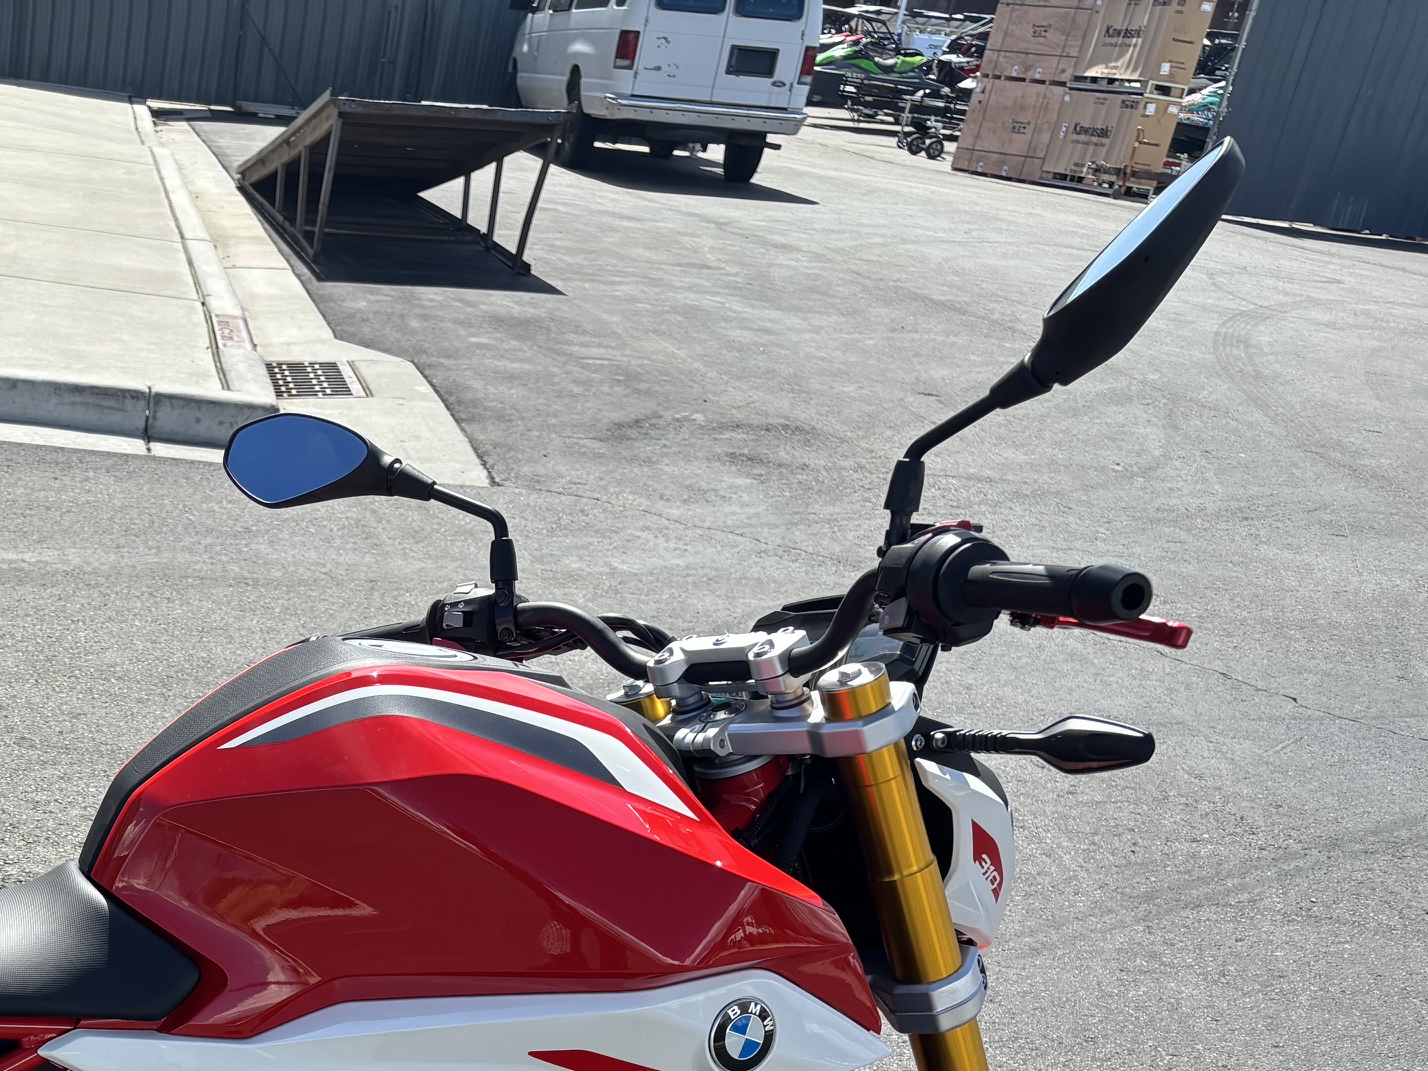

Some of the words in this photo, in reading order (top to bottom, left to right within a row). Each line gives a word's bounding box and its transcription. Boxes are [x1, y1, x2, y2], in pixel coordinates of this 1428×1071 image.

[1072, 122, 1113, 139] Kawasaki
[976, 854, 1001, 890] 310
[727, 1002, 774, 1031] BMW
